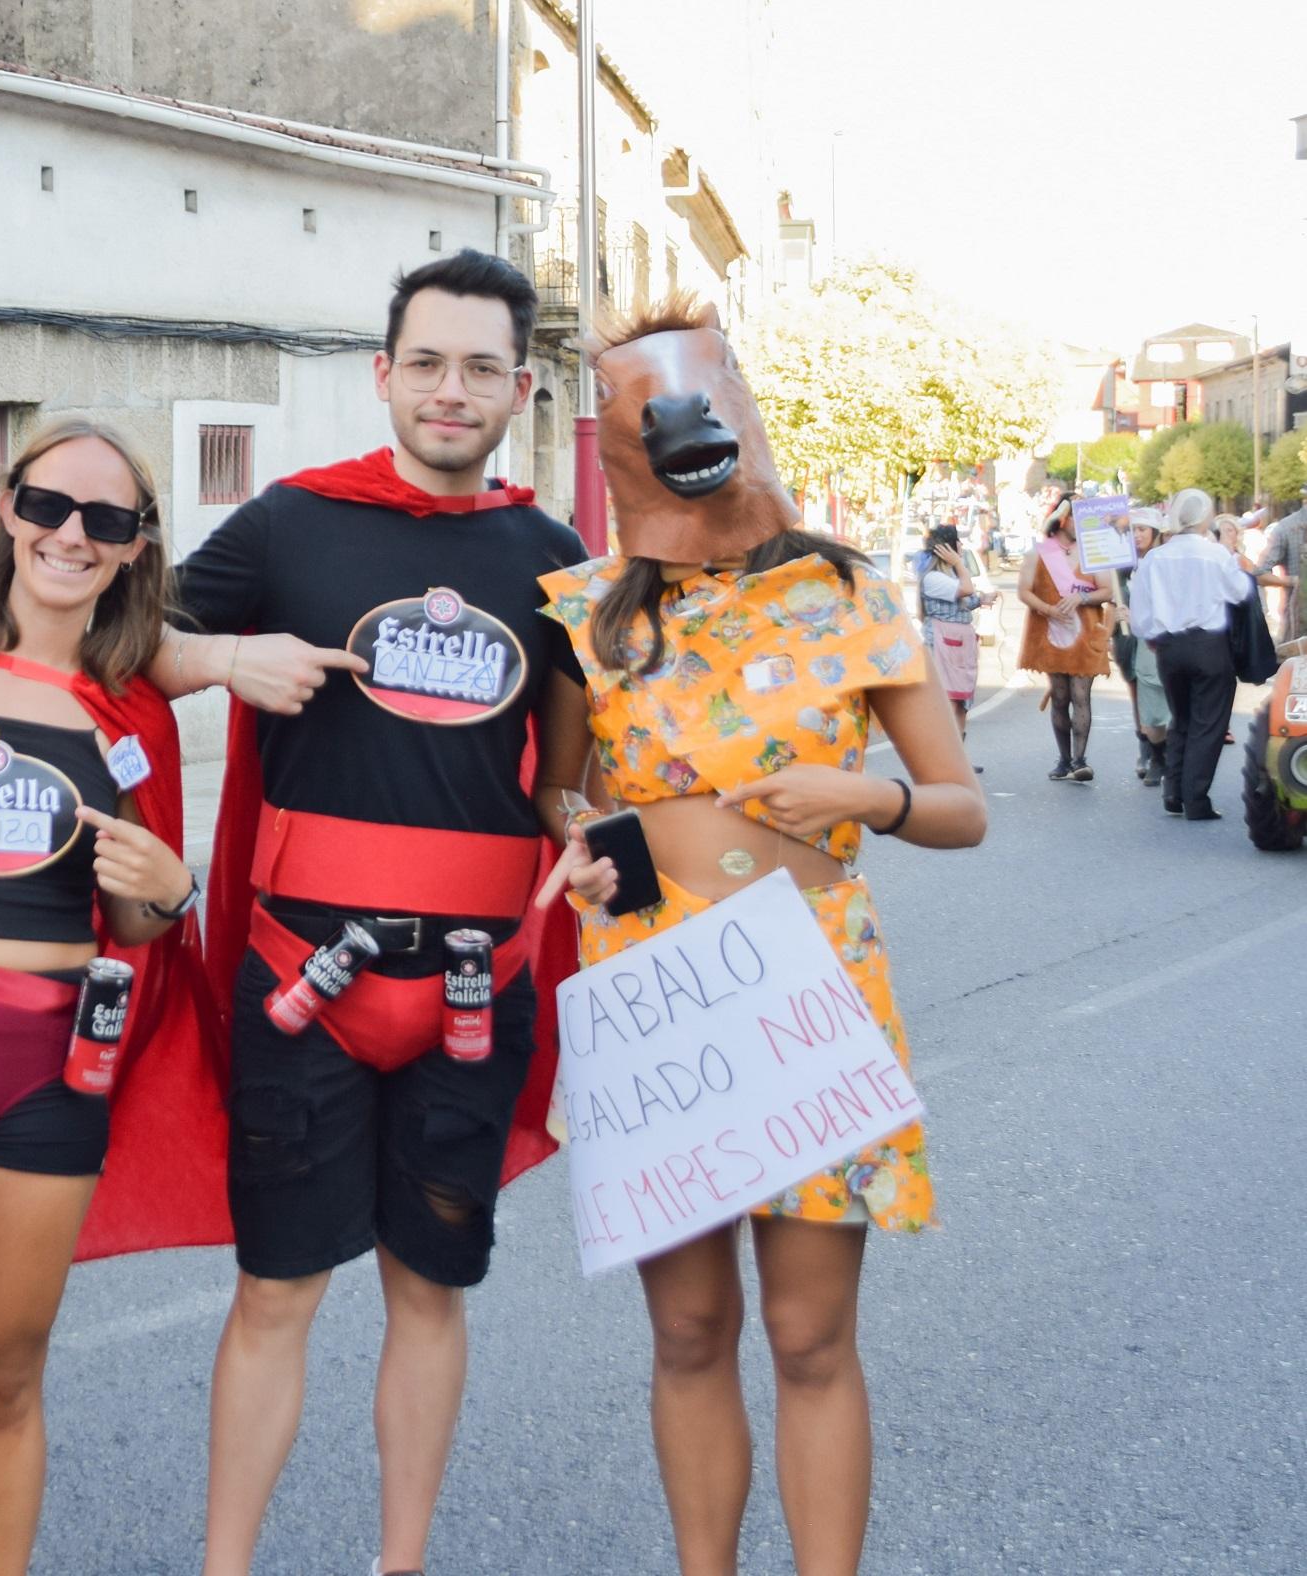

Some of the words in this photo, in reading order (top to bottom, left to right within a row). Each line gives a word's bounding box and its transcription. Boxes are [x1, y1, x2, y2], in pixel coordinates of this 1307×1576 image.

[372, 616, 507, 665] Estrella
[444, 970, 492, 988] Estrella
[445, 986, 491, 1004] Galicia
[564, 919, 765, 1058] CABALO
[756, 968, 869, 1066] NON
[622, 1128, 766, 1236] MIRES
[764, 1113, 800, 1159] O
[793, 1059, 918, 1148] DENTE
